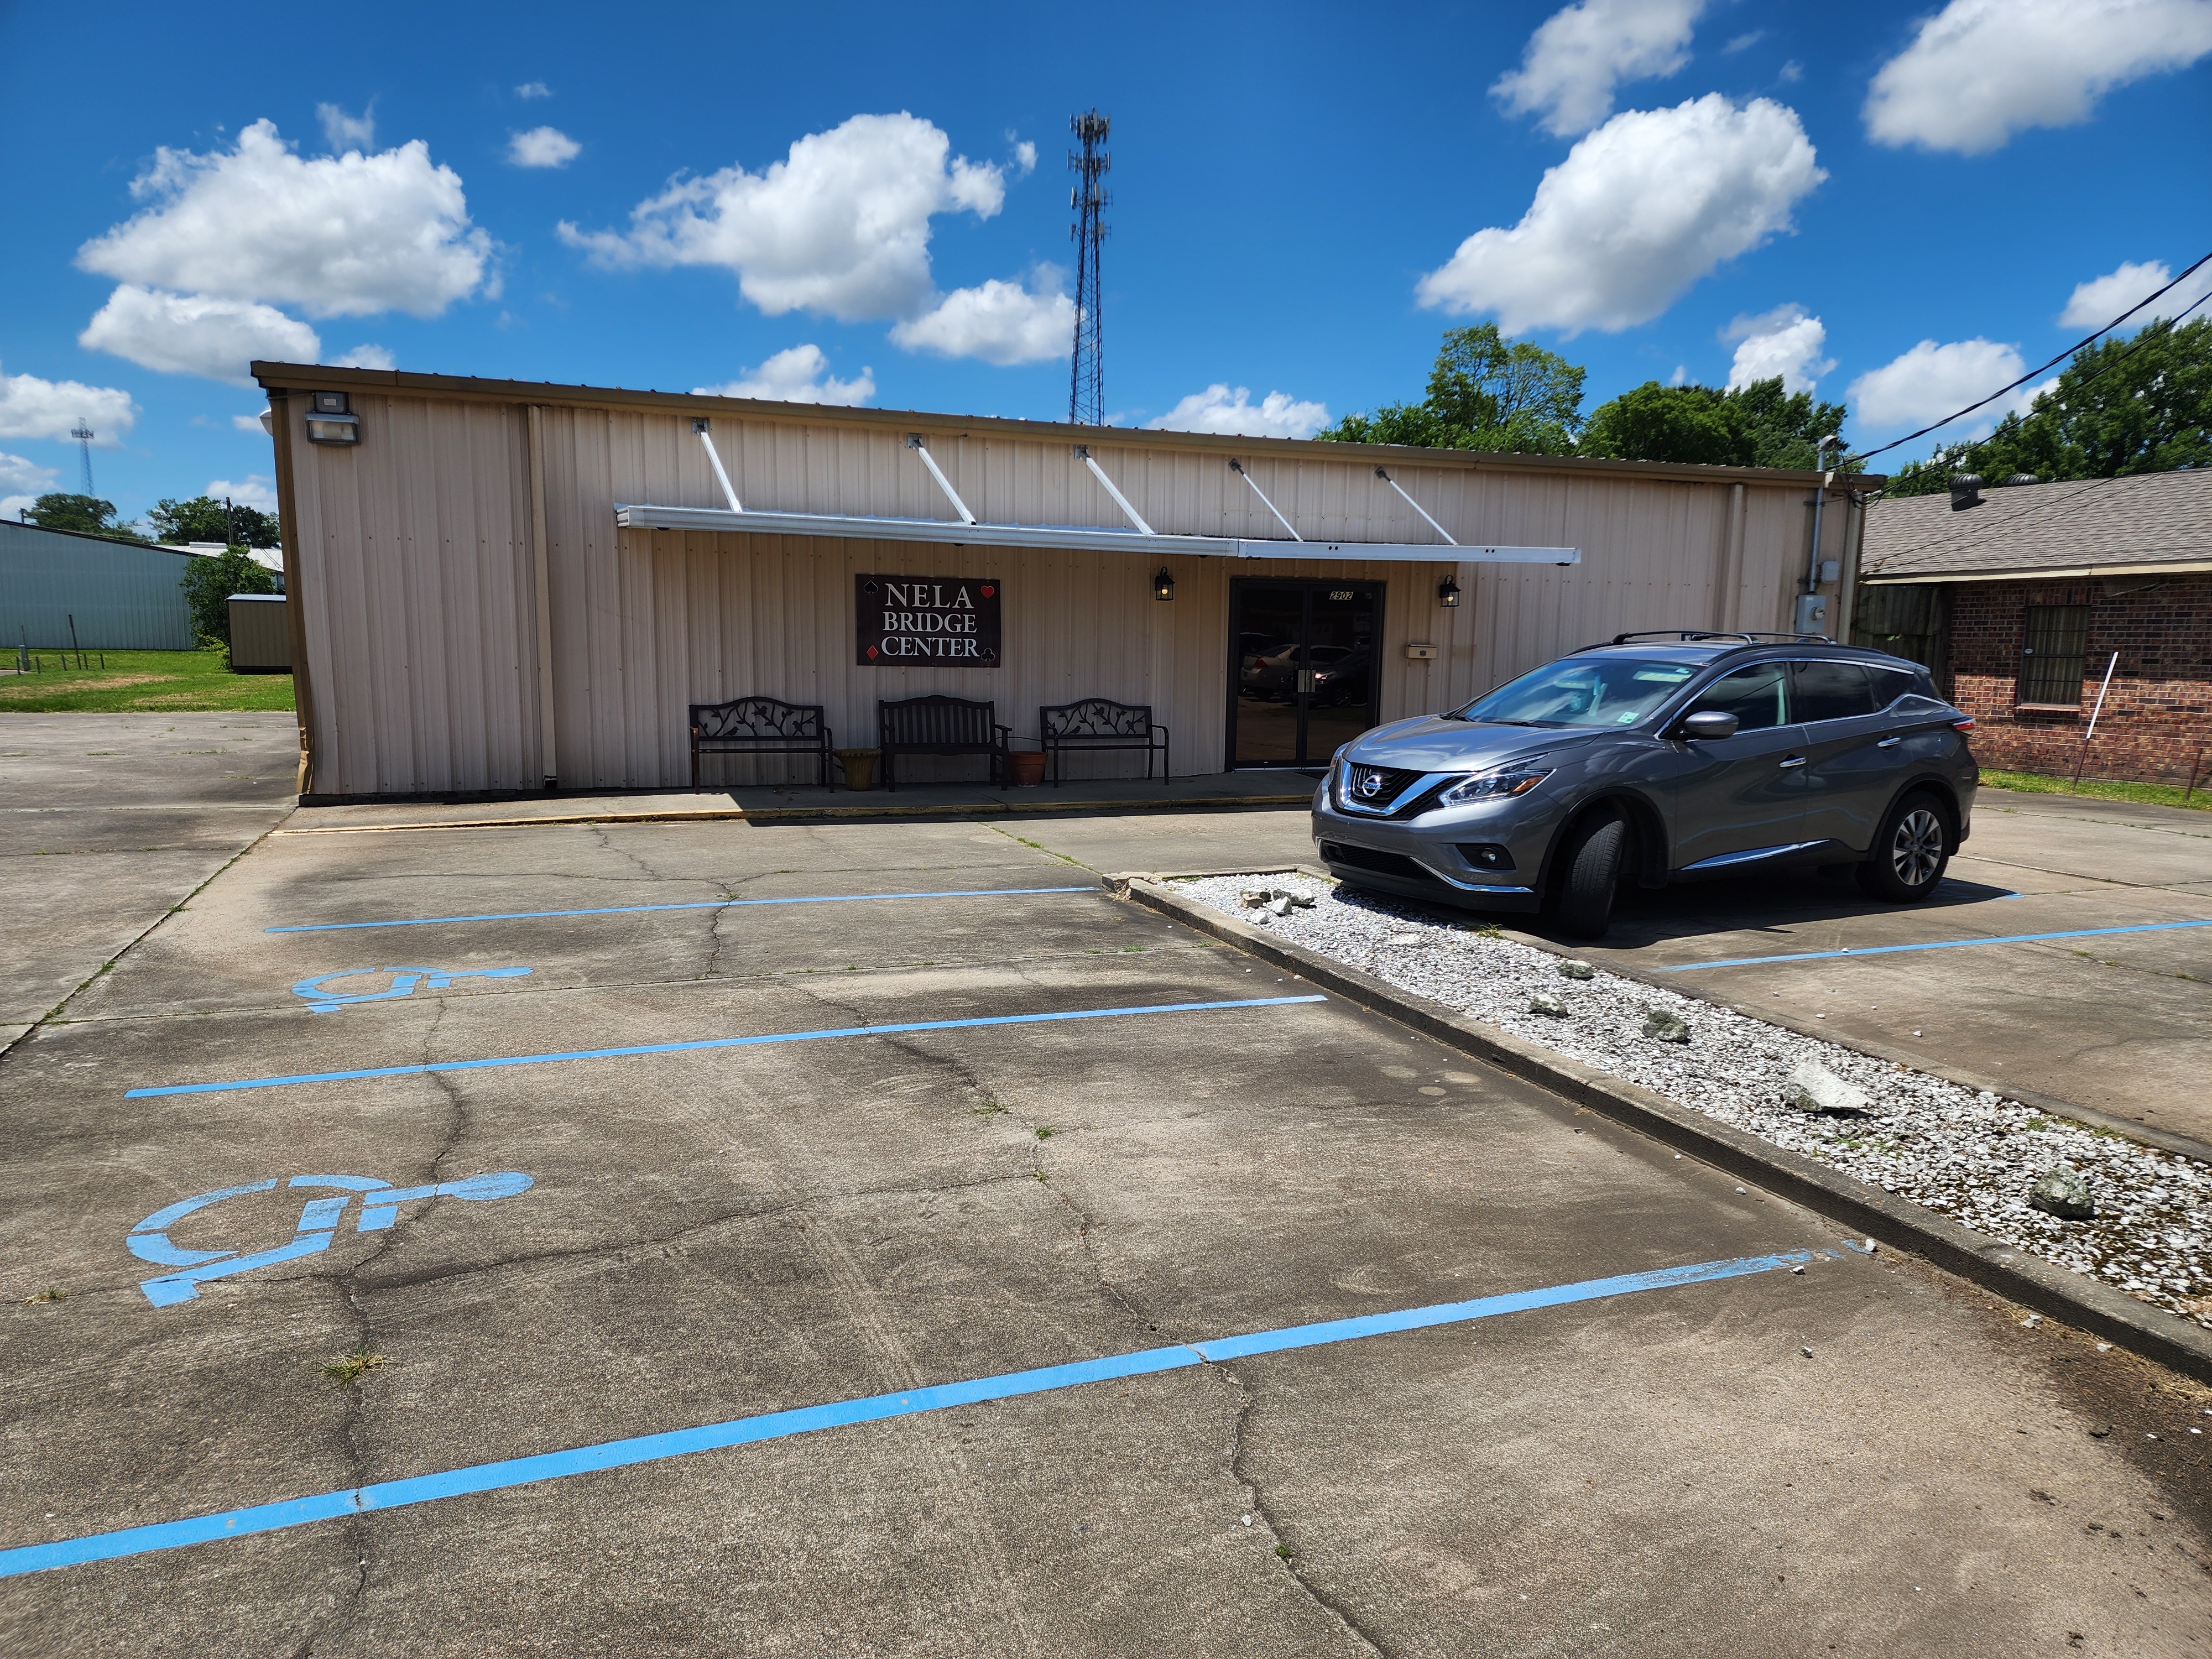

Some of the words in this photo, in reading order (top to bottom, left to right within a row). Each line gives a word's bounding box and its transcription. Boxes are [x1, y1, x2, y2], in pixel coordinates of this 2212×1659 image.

[885, 583, 974, 609] NELA
[882, 612, 977, 633] BRIDGE
[881, 636, 980, 657] CENTER
